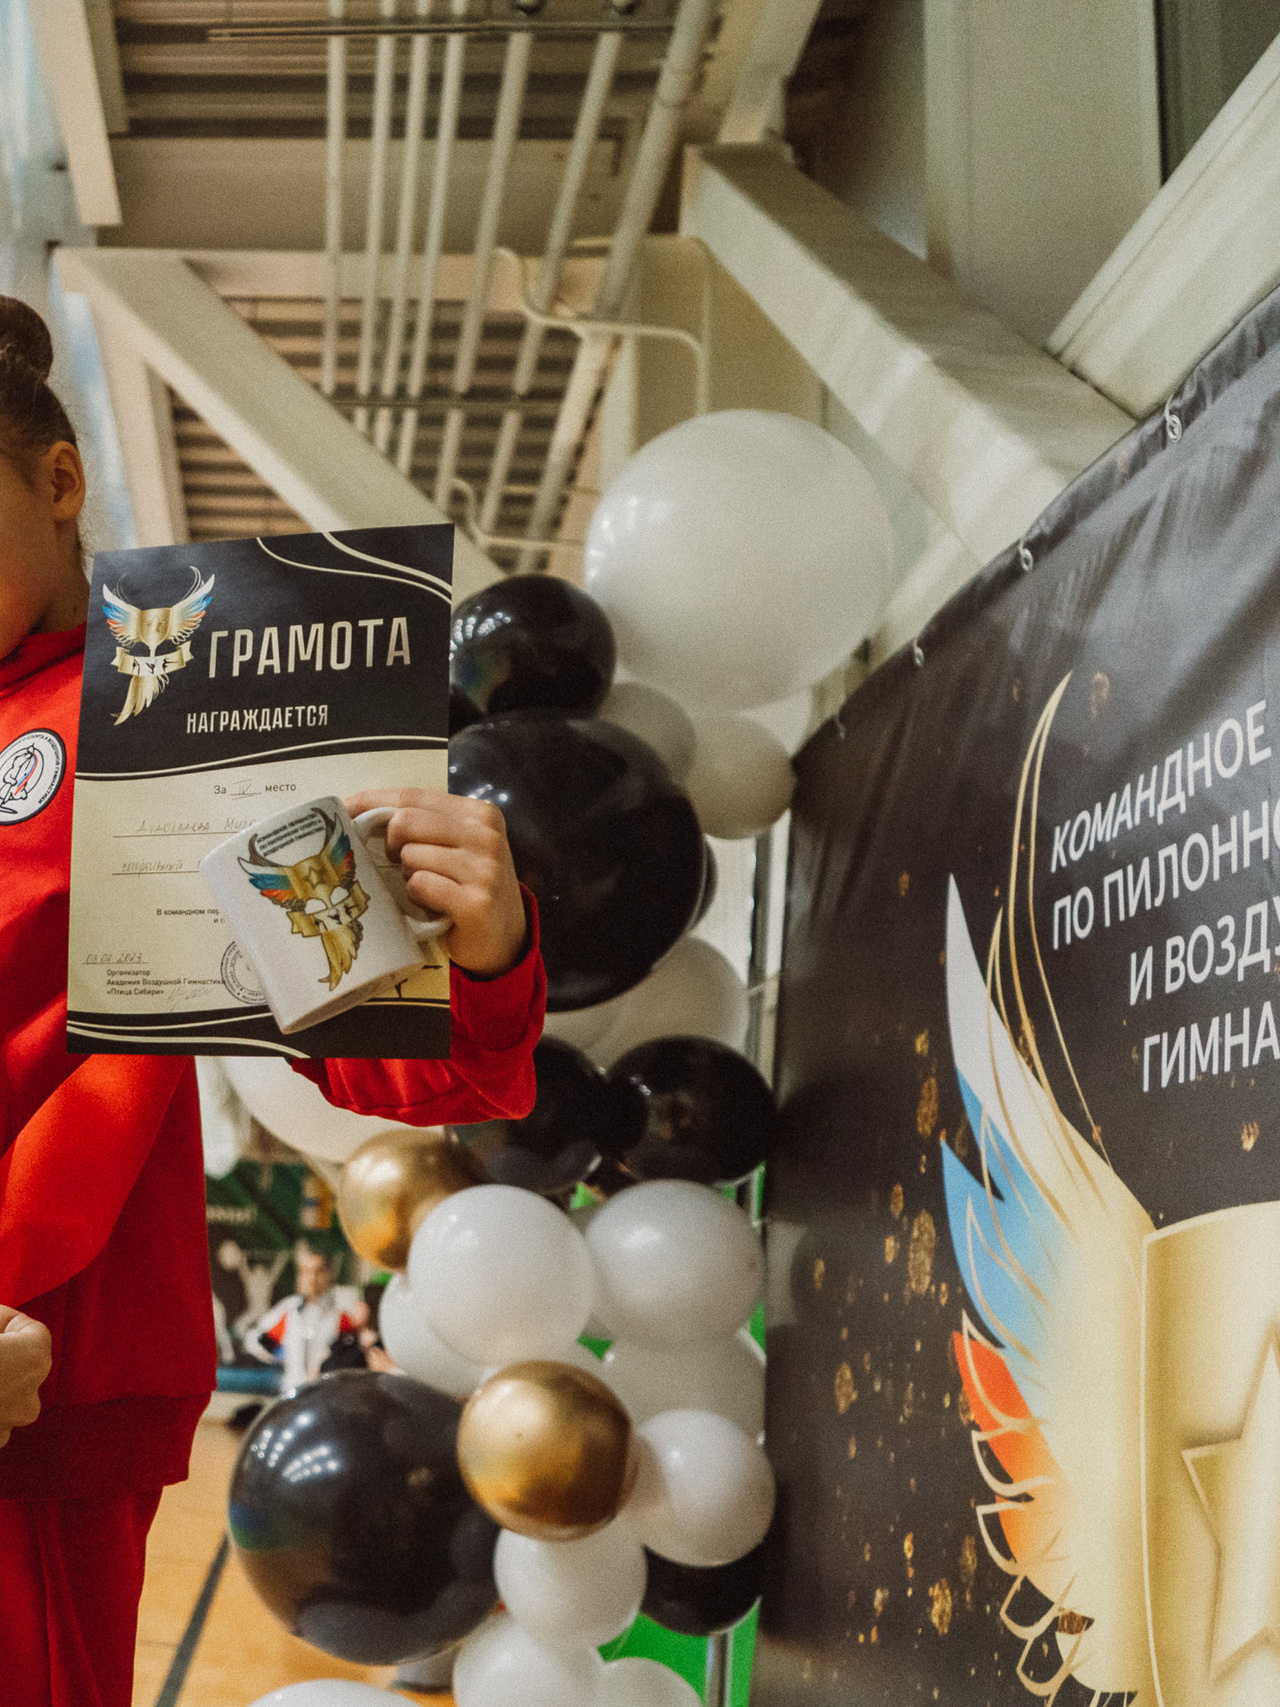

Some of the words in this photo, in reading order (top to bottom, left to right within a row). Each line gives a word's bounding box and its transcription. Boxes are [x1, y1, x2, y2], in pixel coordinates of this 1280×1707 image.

[208, 616, 412, 679] ГРАМОТА
[186, 704, 329, 734] НАГРАЖДАЕТСЯ
[213, 785, 227, 795] За
[264, 783, 297, 792] место
[1050, 699, 1272, 874] КОМАНДНОЕ
[156, 908, 162, 916] В
[1053, 886, 1094, 950] ПО
[1129, 945, 1153, 1006] И
[1165, 895, 1280, 994] ВОЗД
[106, 968, 151, 977] Организатор
[106, 978, 141, 986] Академия
[142, 977, 182, 987] Воздушной
[106, 988, 132, 996] «Птица
[133, 988, 165, 996] Сибири»
[1142, 1001, 1280, 1093] ГИМНА
